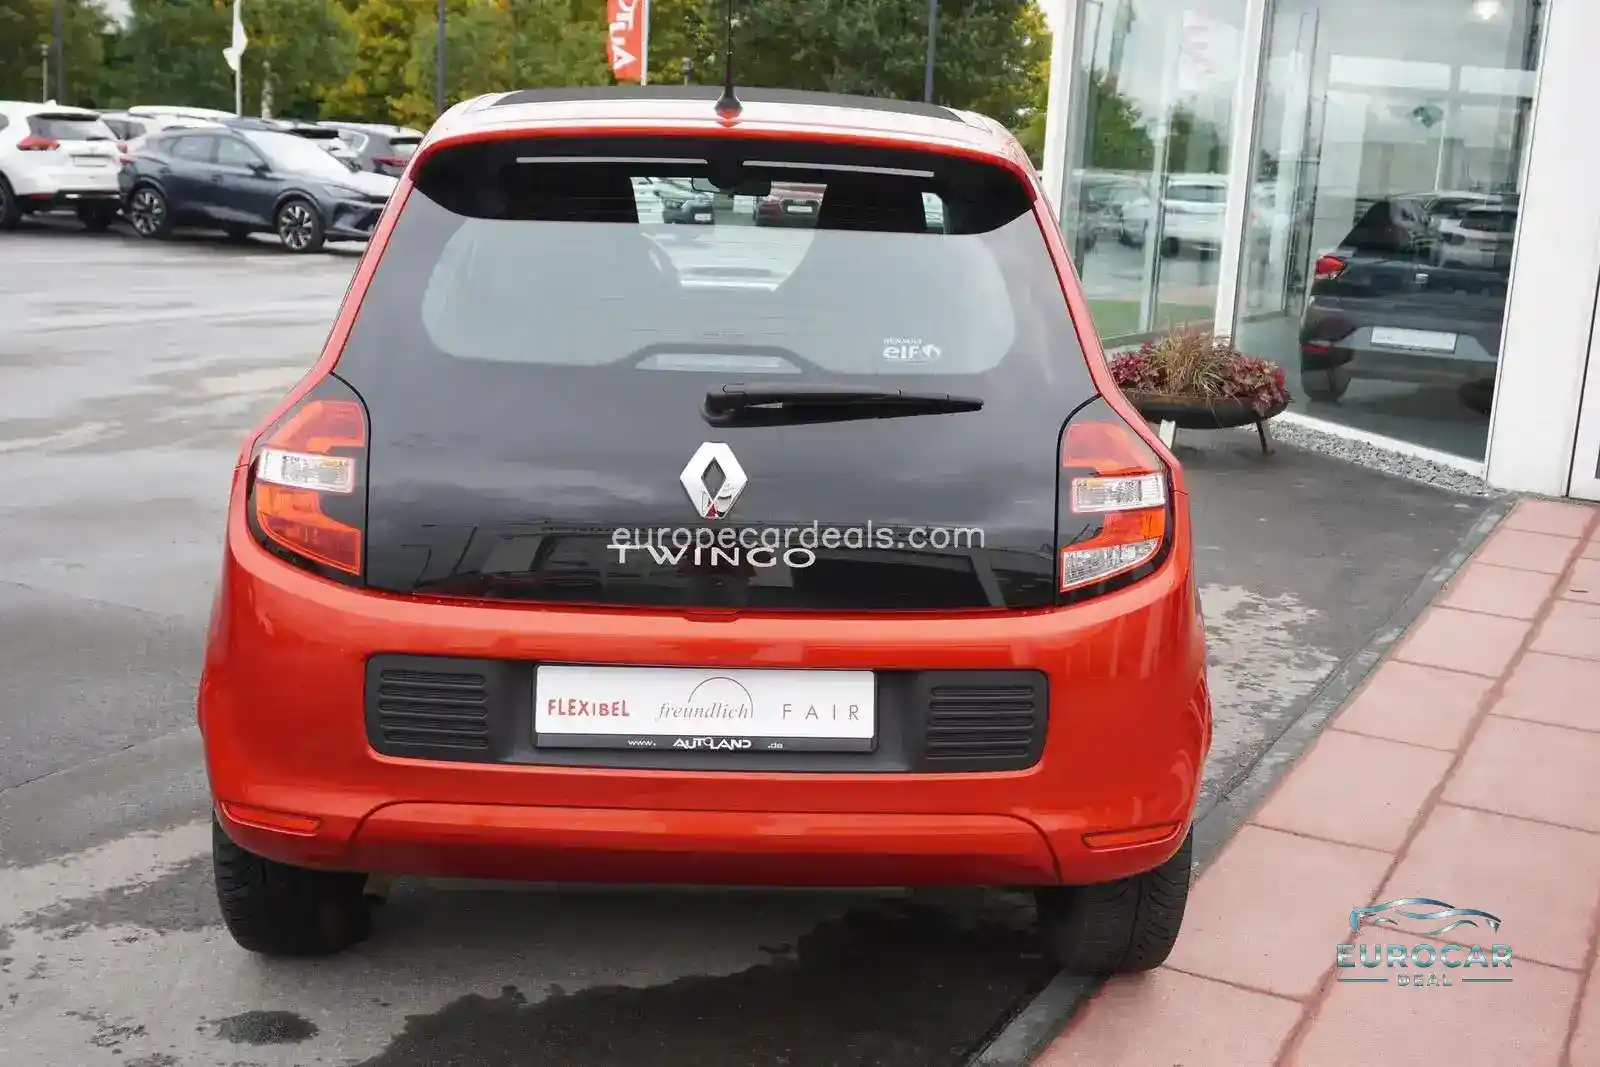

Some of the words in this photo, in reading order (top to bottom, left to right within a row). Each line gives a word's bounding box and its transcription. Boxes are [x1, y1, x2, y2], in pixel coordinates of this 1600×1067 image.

[606, 544, 817, 568] TWINGO
[547, 699, 630, 717] FLEXIBEL
[656, 702, 748, 721] freundlich
